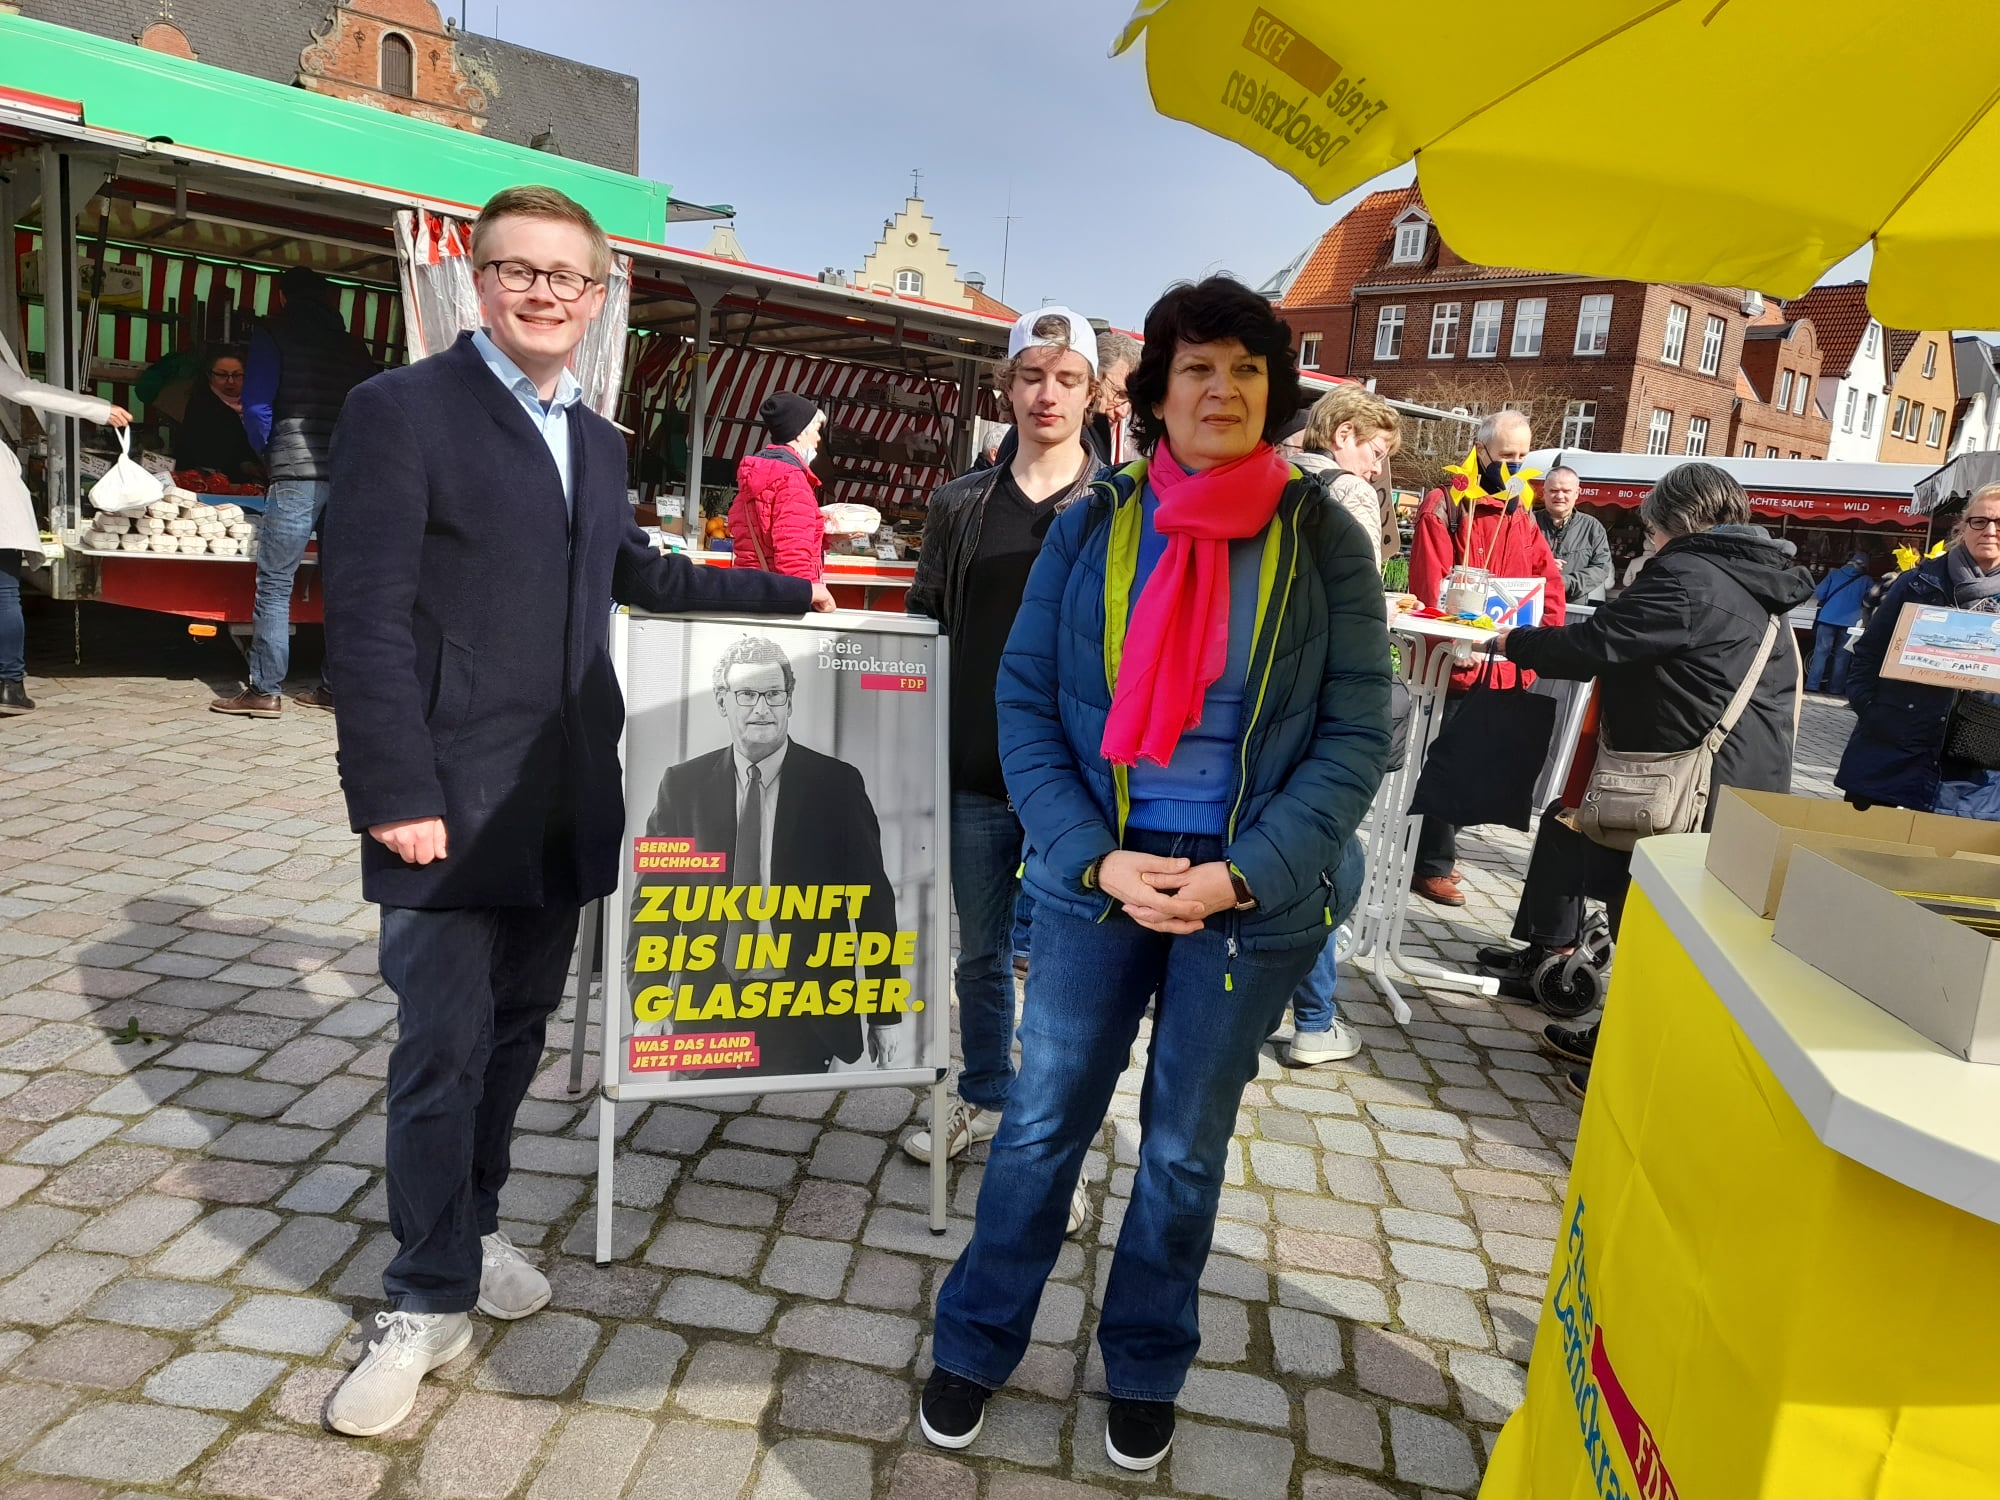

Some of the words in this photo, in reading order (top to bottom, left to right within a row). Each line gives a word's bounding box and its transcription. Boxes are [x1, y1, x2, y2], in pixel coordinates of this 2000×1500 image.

[1579, 487, 1600, 496] URST
[1618, 489, 1634, 498] BIO
[1749, 497, 1780, 507] ACHTE
[1780, 499, 1815, 509] SALATE
[1843, 502, 1870, 512] WILD
[818, 638, 862, 655] Freie
[818, 654, 927, 675] Demokraten
[900, 678, 925, 689] FDP
[639, 842, 690, 853] BERND
[639, 856, 721, 868] BUCHHOLZ
[633, 885, 871, 922] ZUKUNFT
[634, 934, 718, 972] BIS
[734, 933, 792, 970] IN
[805, 931, 918, 968] JEDE
[633, 978, 925, 1023] GLASFASER.
[634, 1040, 669, 1052] WAS
[673, 1038, 704, 1051] DAS
[709, 1036, 751, 1049] LAND
[633, 1054, 678, 1068] JETZT
[681, 1051, 755, 1066] BRAUCHT.
[1553, 1258, 1630, 1500] Demokra
